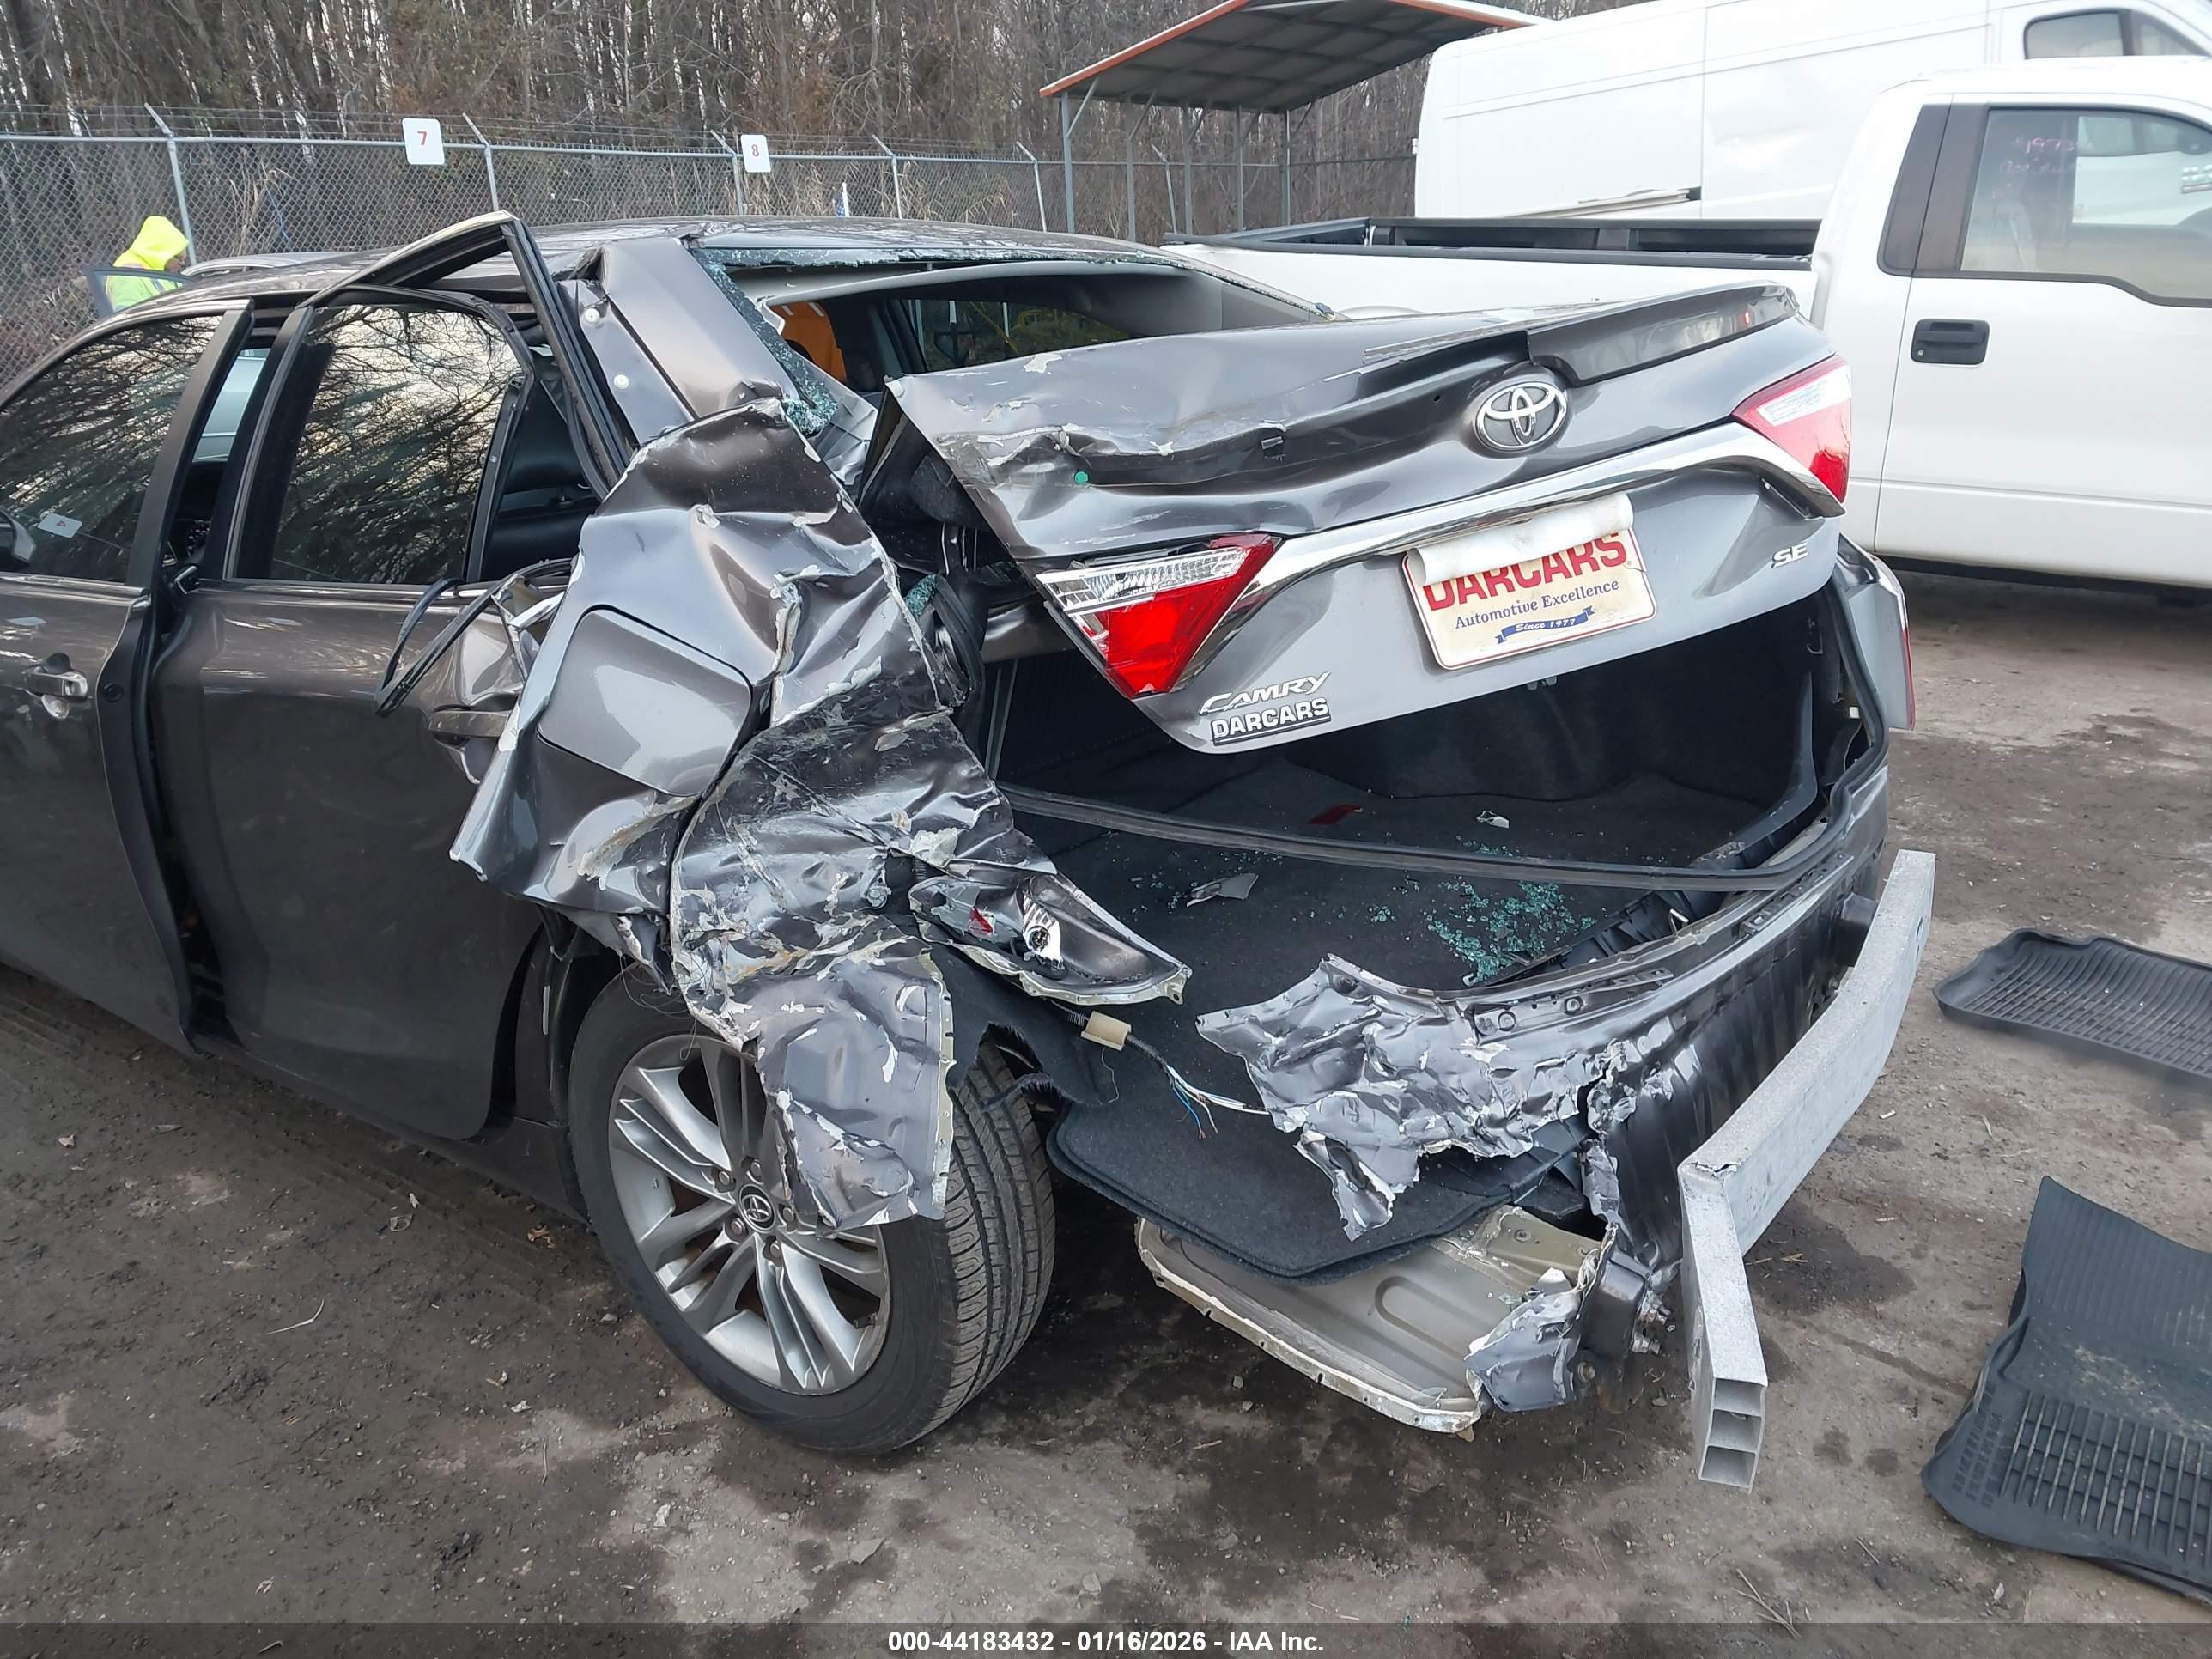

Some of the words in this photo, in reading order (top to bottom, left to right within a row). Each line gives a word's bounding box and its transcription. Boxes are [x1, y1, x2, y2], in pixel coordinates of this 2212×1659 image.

[417, 131, 428, 146] 7
[751, 144, 760, 157] 8
[1771, 542, 1808, 568] SE
[1455, 600, 1539, 629] Automotive
[1542, 580, 1620, 609] Excellence
[1516, 622, 1546, 632] Since
[1549, 618, 1577, 630] 1977
[1199, 672, 1331, 715] CAMRY
[1211, 697, 1330, 739] DARCARS
